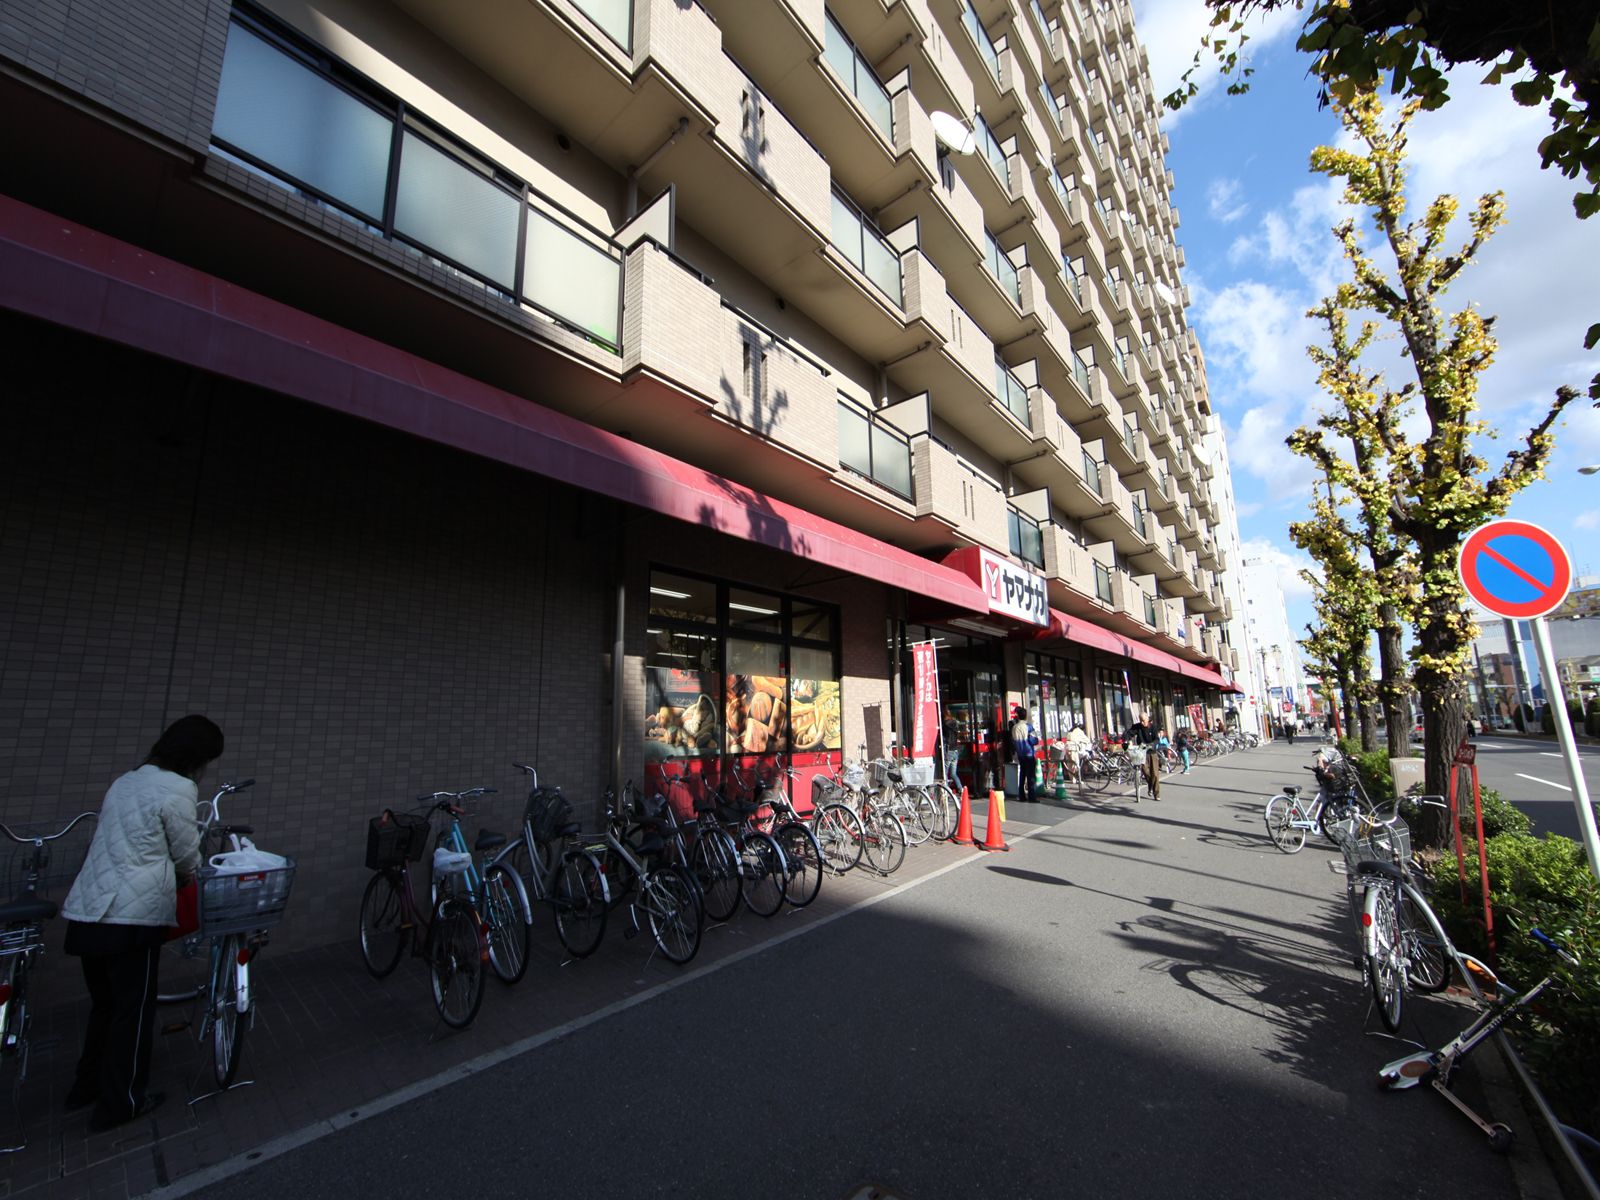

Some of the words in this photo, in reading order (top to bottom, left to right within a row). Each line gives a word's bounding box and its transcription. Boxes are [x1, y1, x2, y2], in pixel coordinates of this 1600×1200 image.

[985, 561, 1000, 599] Y
[1003, 569, 1045, 616] ヤマナカ
